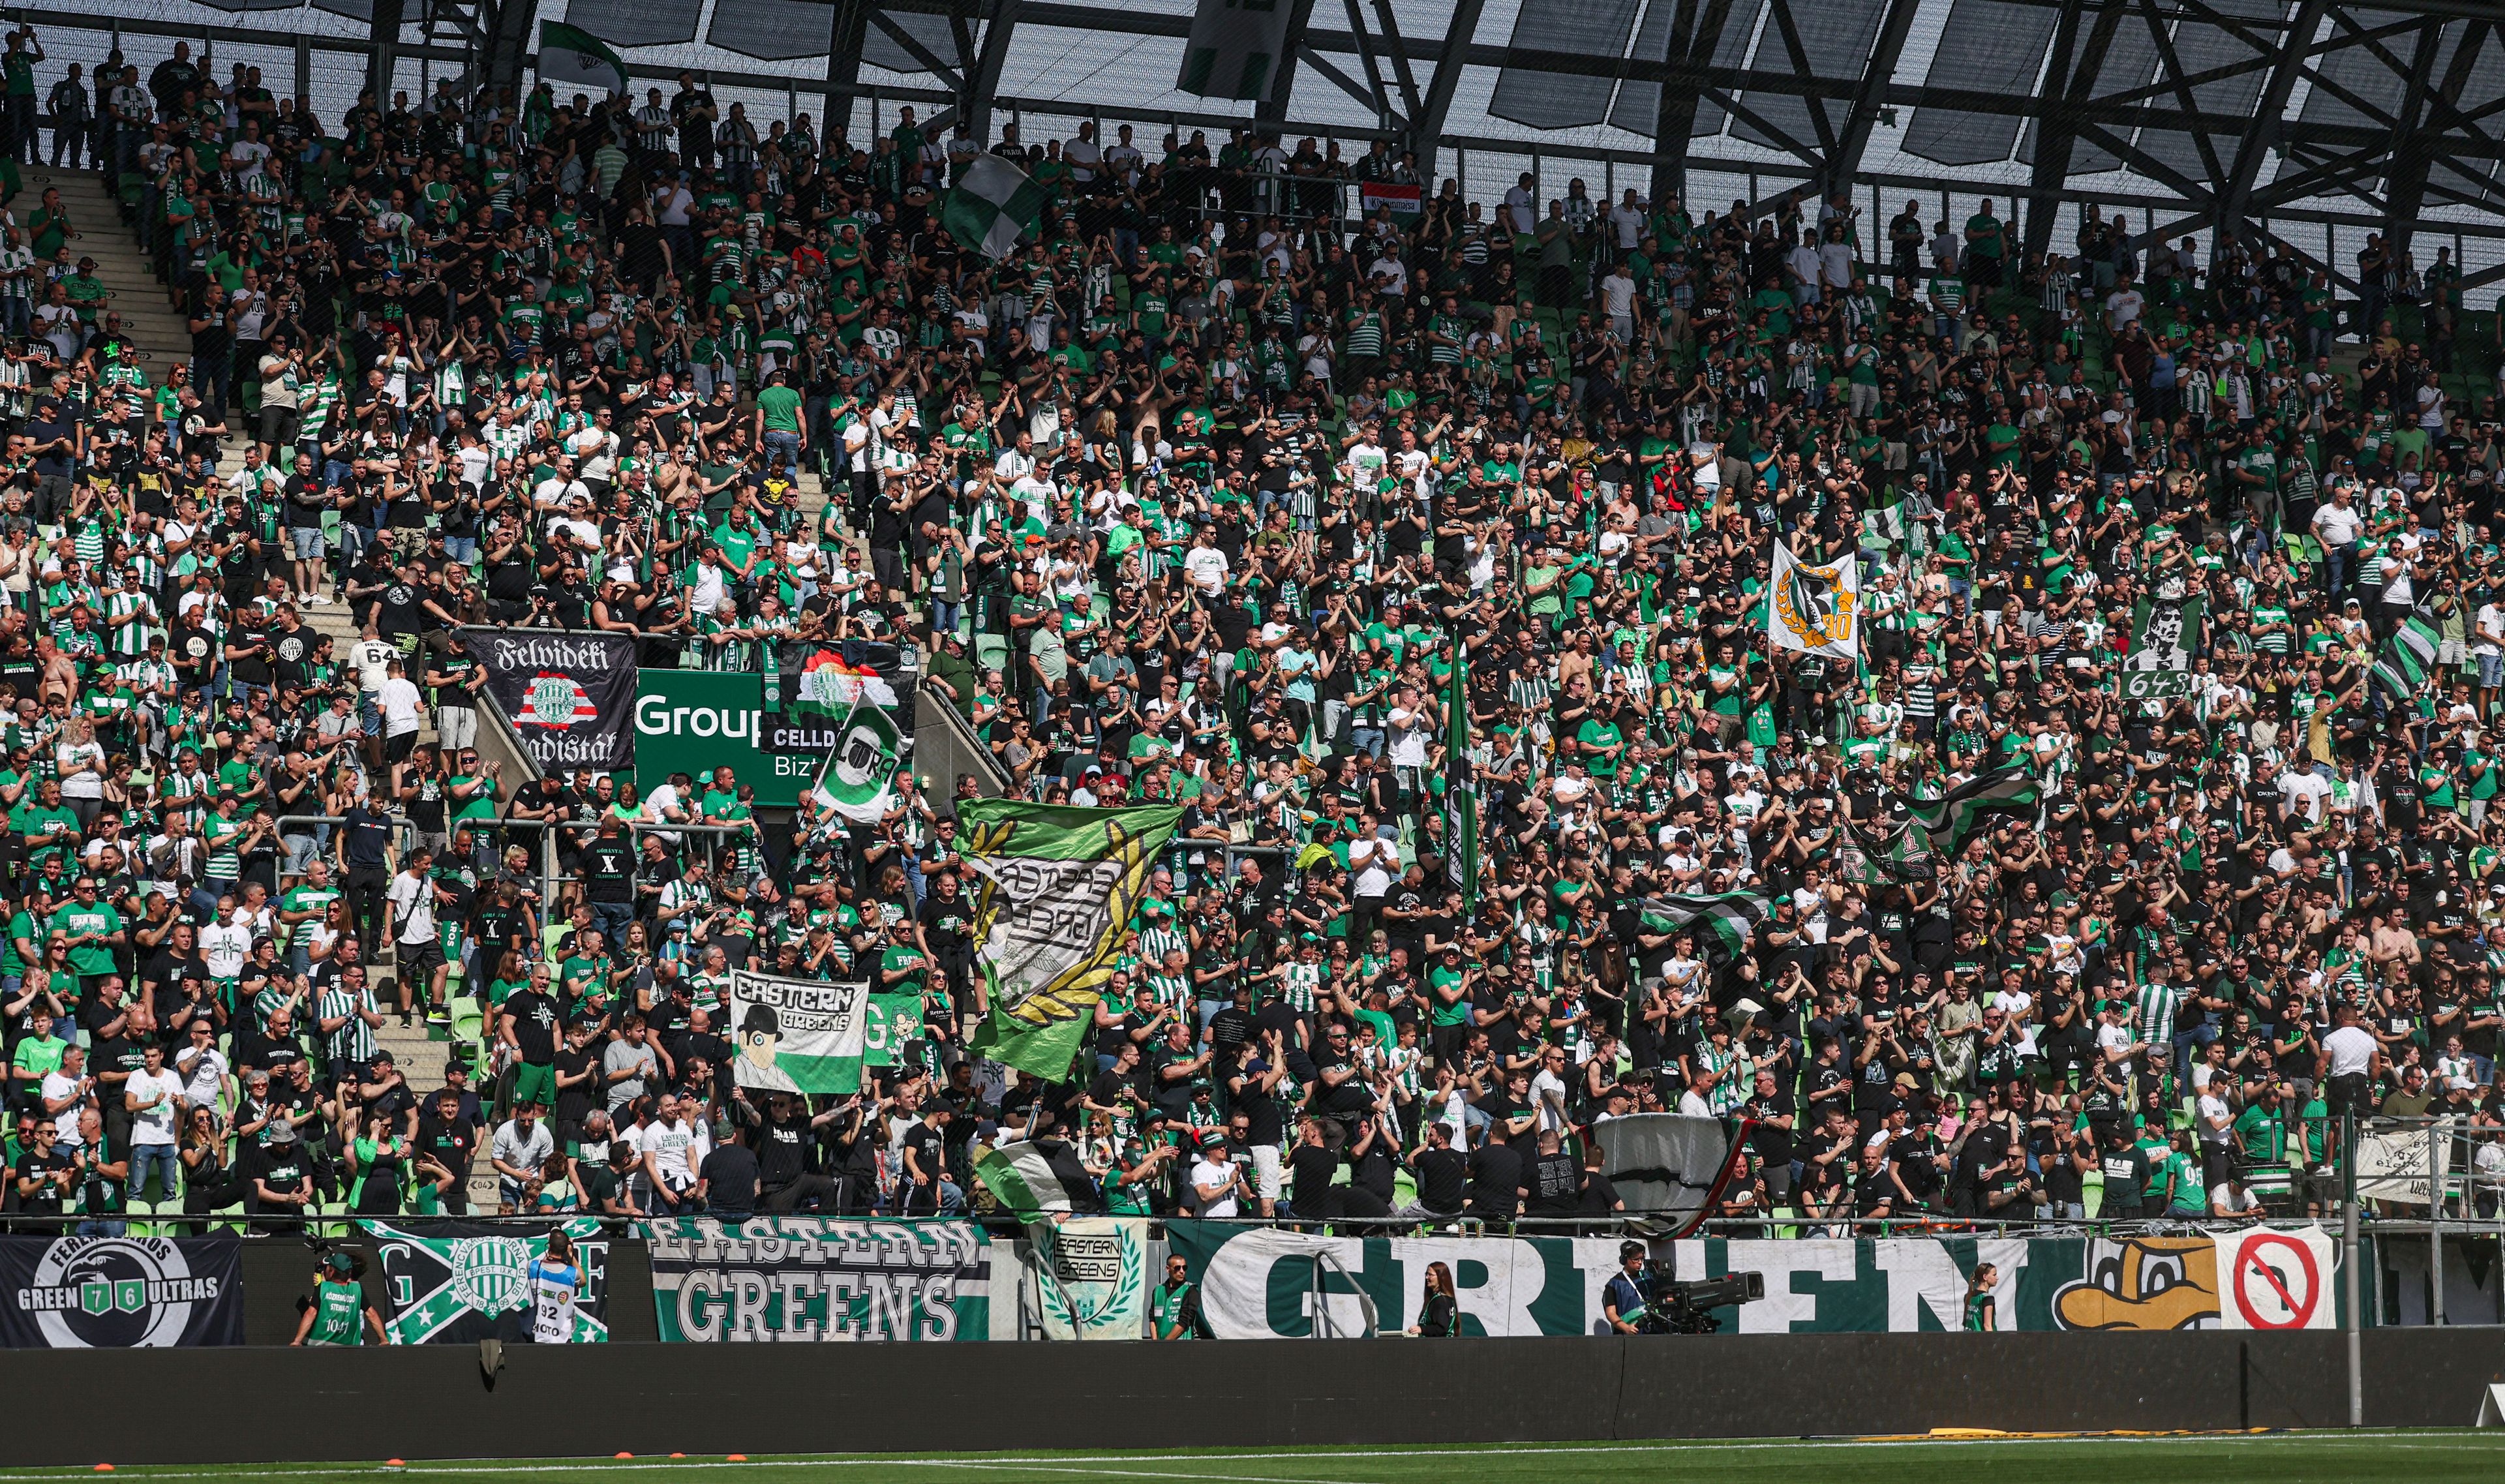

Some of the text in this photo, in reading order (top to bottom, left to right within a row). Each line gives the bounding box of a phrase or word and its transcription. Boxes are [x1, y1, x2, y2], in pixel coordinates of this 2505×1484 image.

[1371, 196, 1416, 211] Kiskunmajsa
[1822, 614, 1852, 641] 90
[366, 648, 394, 663] 64
[494, 639, 610, 671] Felvidéki
[2129, 673, 2191, 697] 648
[774, 729, 836, 748] CELLD
[579, 808, 598, 823] 35
[601, 855, 619, 873] X.
[485, 919, 500, 938] X.
[735, 974, 855, 1012] EASTERN
[782, 1012, 851, 1031] GREENS
[865, 1001, 888, 1050] G
[2185, 1166, 2204, 1187] 95
[2409, 1179, 2442, 1198] Ultr
[50, 1237, 171, 1268] FEREOS
[648, 1215, 980, 1269] EASTERN
[1056, 1239, 1121, 1254] EASTERN
[378, 1242, 414, 1307] G
[498, 1237, 524, 1264] TORNA
[511, 1267, 527, 1297] CLUB
[1057, 1262, 1117, 1278] GREENS
[17, 1287, 135, 1310] GREEN 7 6
[147, 1277, 219, 1304] ULTRAS
[541, 1304, 558, 1320] 92
[676, 1268, 960, 1342] GREENS
[326, 1318, 349, 1335] 1041
